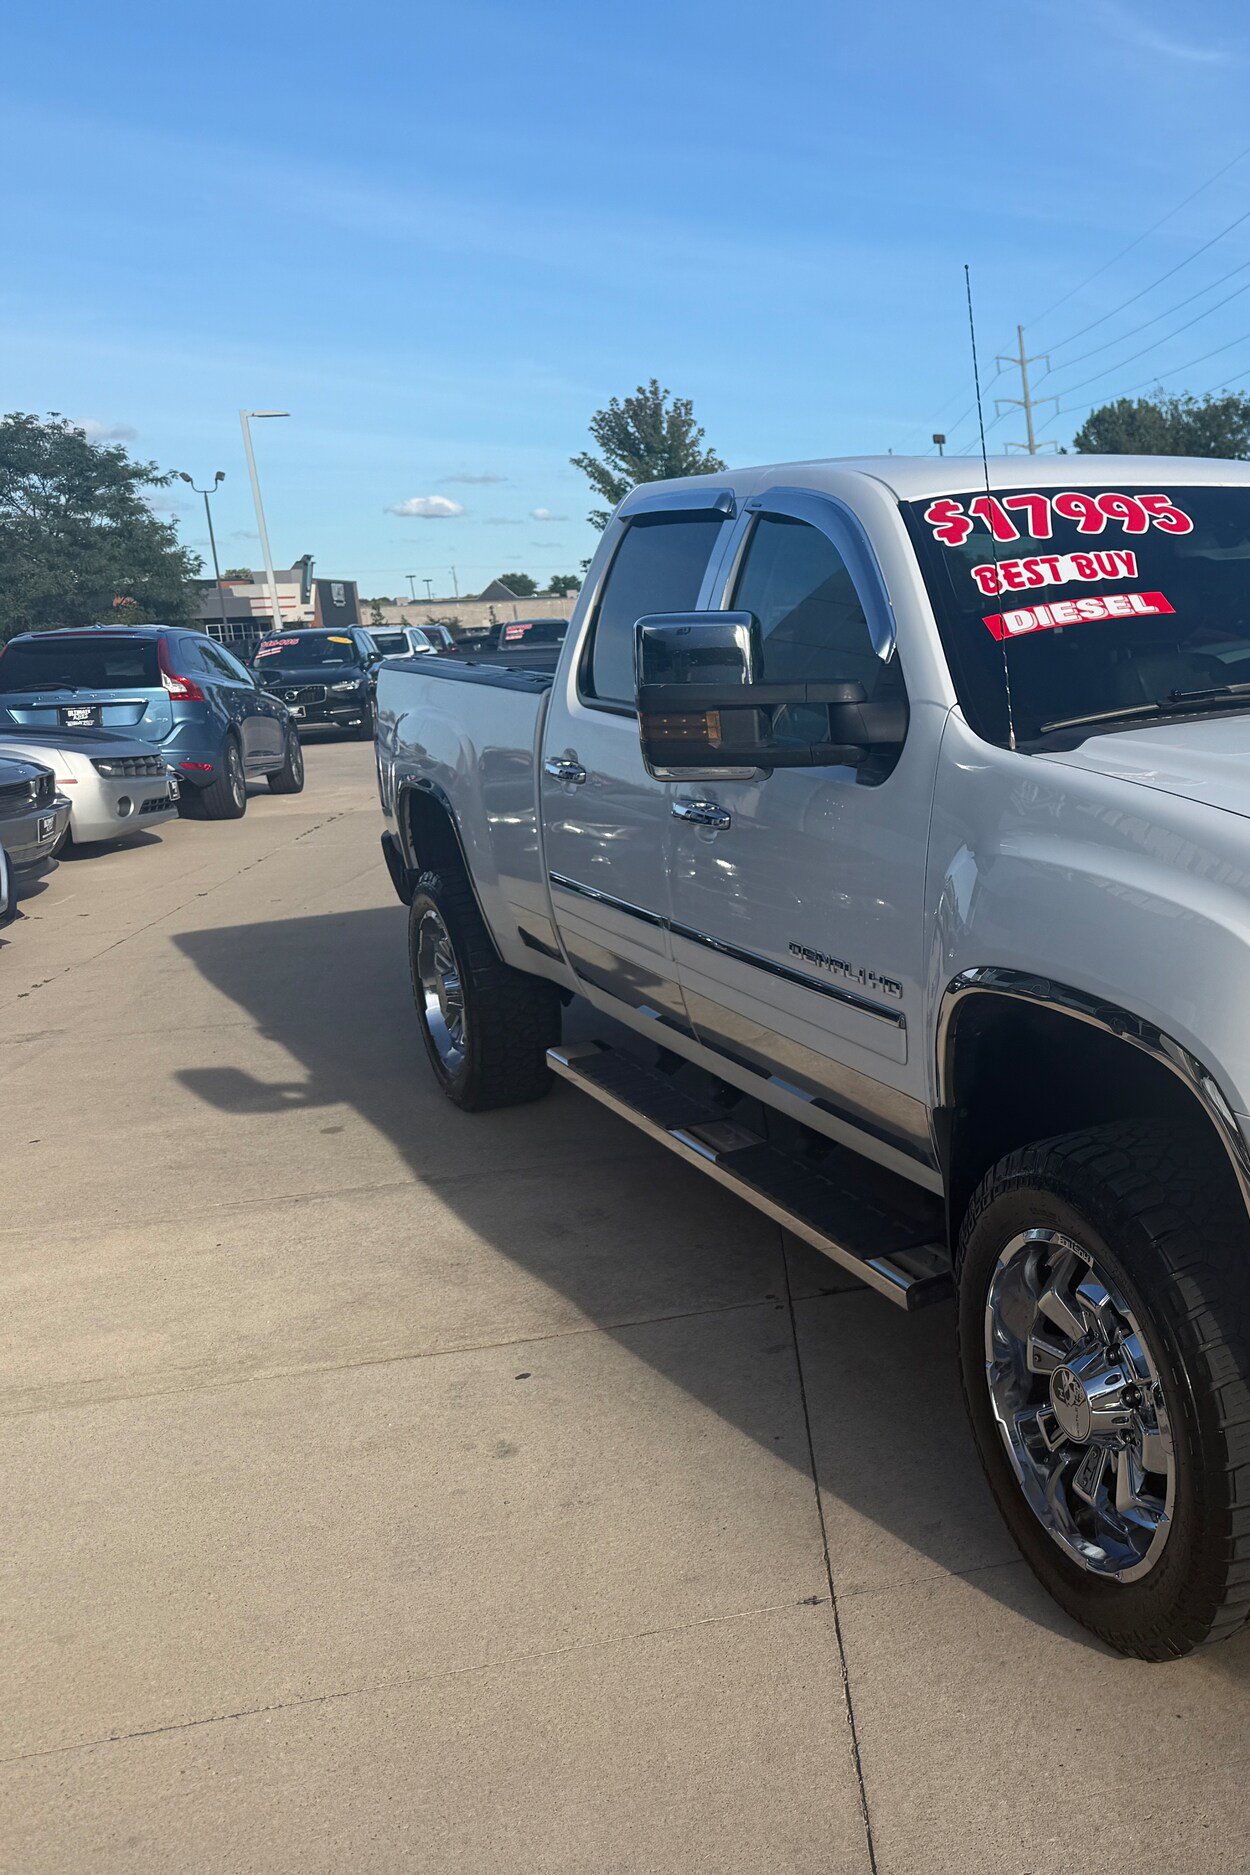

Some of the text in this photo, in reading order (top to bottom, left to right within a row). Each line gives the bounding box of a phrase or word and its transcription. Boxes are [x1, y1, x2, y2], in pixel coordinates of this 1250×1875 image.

[924, 492, 1194, 546] $17995
[973, 550, 1138, 596] BEST BUY
[1003, 593, 1159, 634] DIESEL
[788, 941, 903, 999] DENALI HD
